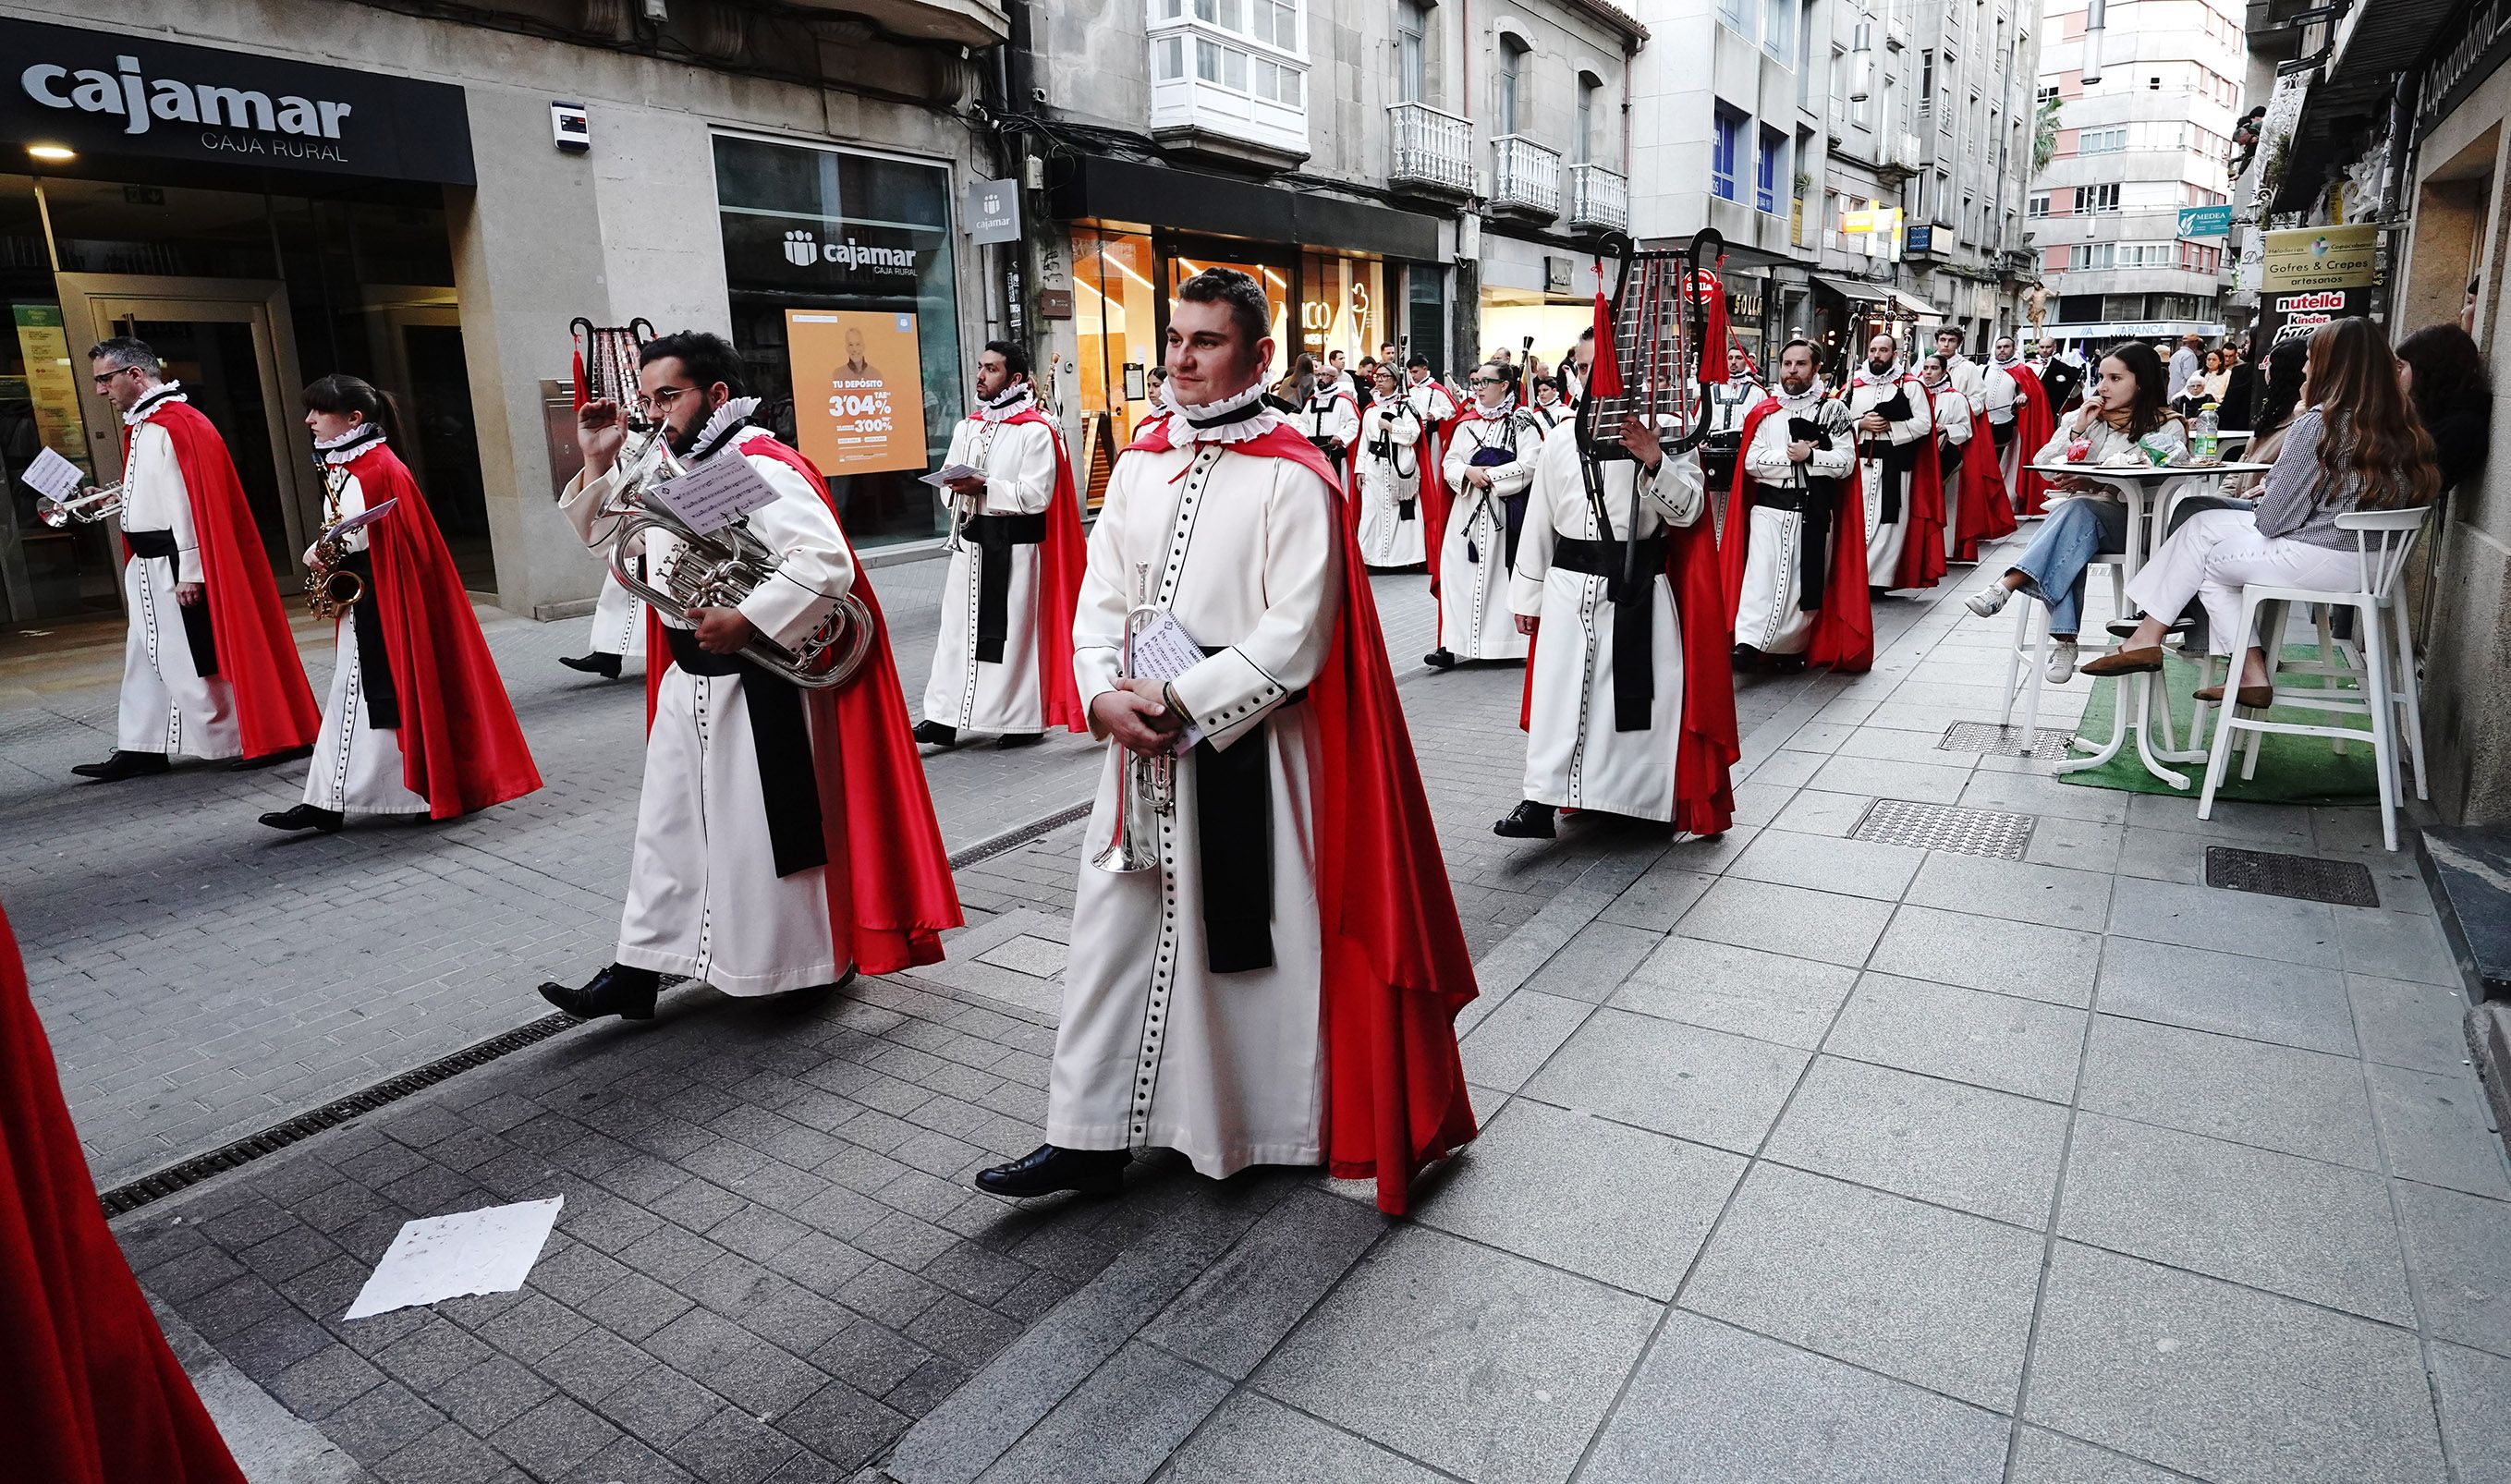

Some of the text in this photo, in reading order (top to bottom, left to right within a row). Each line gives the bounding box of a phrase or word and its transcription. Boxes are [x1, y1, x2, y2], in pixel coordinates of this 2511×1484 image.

[21, 55, 352, 139] cajamar
[201, 132, 348, 163] CAJA RURAL
[2196, 212, 2226, 220] MEDEA
[976, 217, 1011, 230] cajamar
[823, 237, 917, 271] cajamar
[874, 266, 918, 276] CAJA RURAL
[2269, 259, 2369, 274] Gofres & Crepes
[1686, 282, 1713, 292] Slla
[2291, 276, 2343, 286] artesanos
[1734, 294, 1762, 316] SOLLA
[2279, 294, 2342, 310] nutella
[832, 378, 884, 388] TU DEPÓSITO
